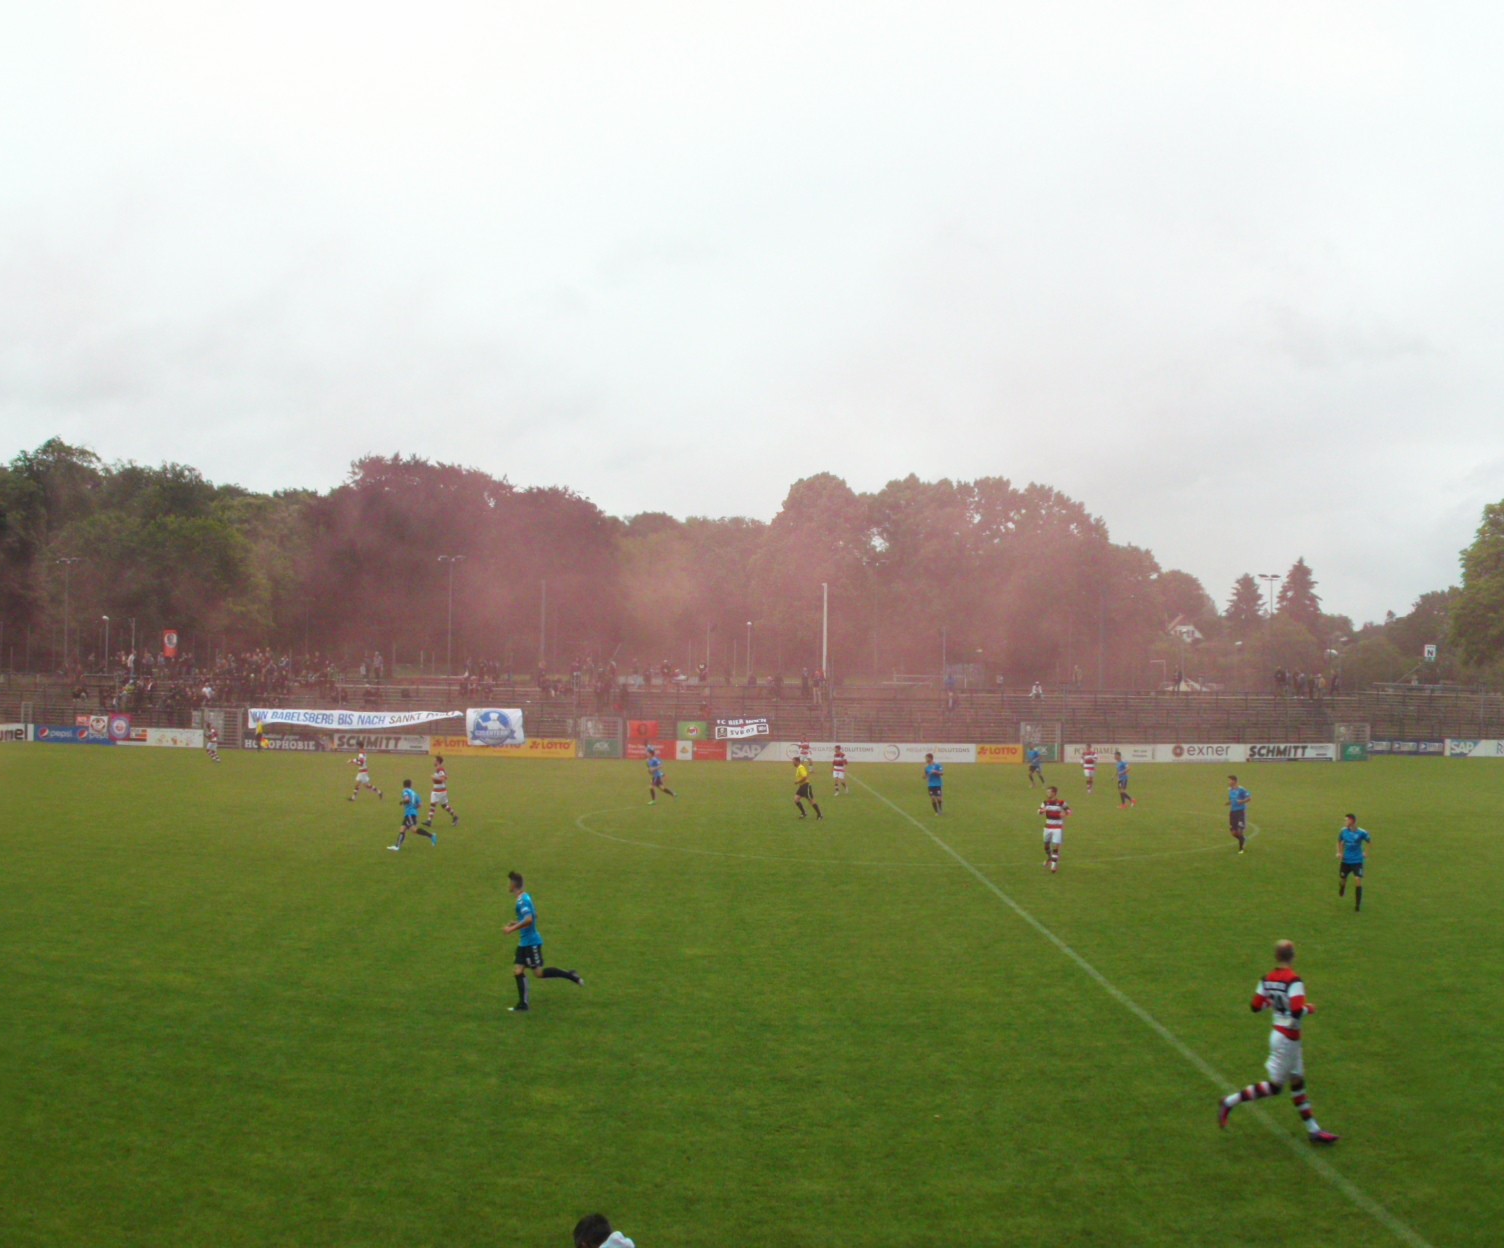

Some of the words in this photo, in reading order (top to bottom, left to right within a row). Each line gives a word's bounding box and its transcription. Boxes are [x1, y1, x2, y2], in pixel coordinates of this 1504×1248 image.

[271, 711, 334, 725] BABELSBERG
[338, 713, 354, 724] BIS
[357, 715, 385, 725] NACH
[245, 739, 316, 750] HOOPHOBIE
[336, 735, 401, 748] SCHMITT
[542, 742, 570, 750] LOTTO
[733, 746, 760, 758] SAP
[989, 747, 1017, 755] LOTTO
[1187, 746, 1231, 756] exner
[1249, 745, 1309, 758] SCHMITT
[1450, 742, 1475, 753] SAP
